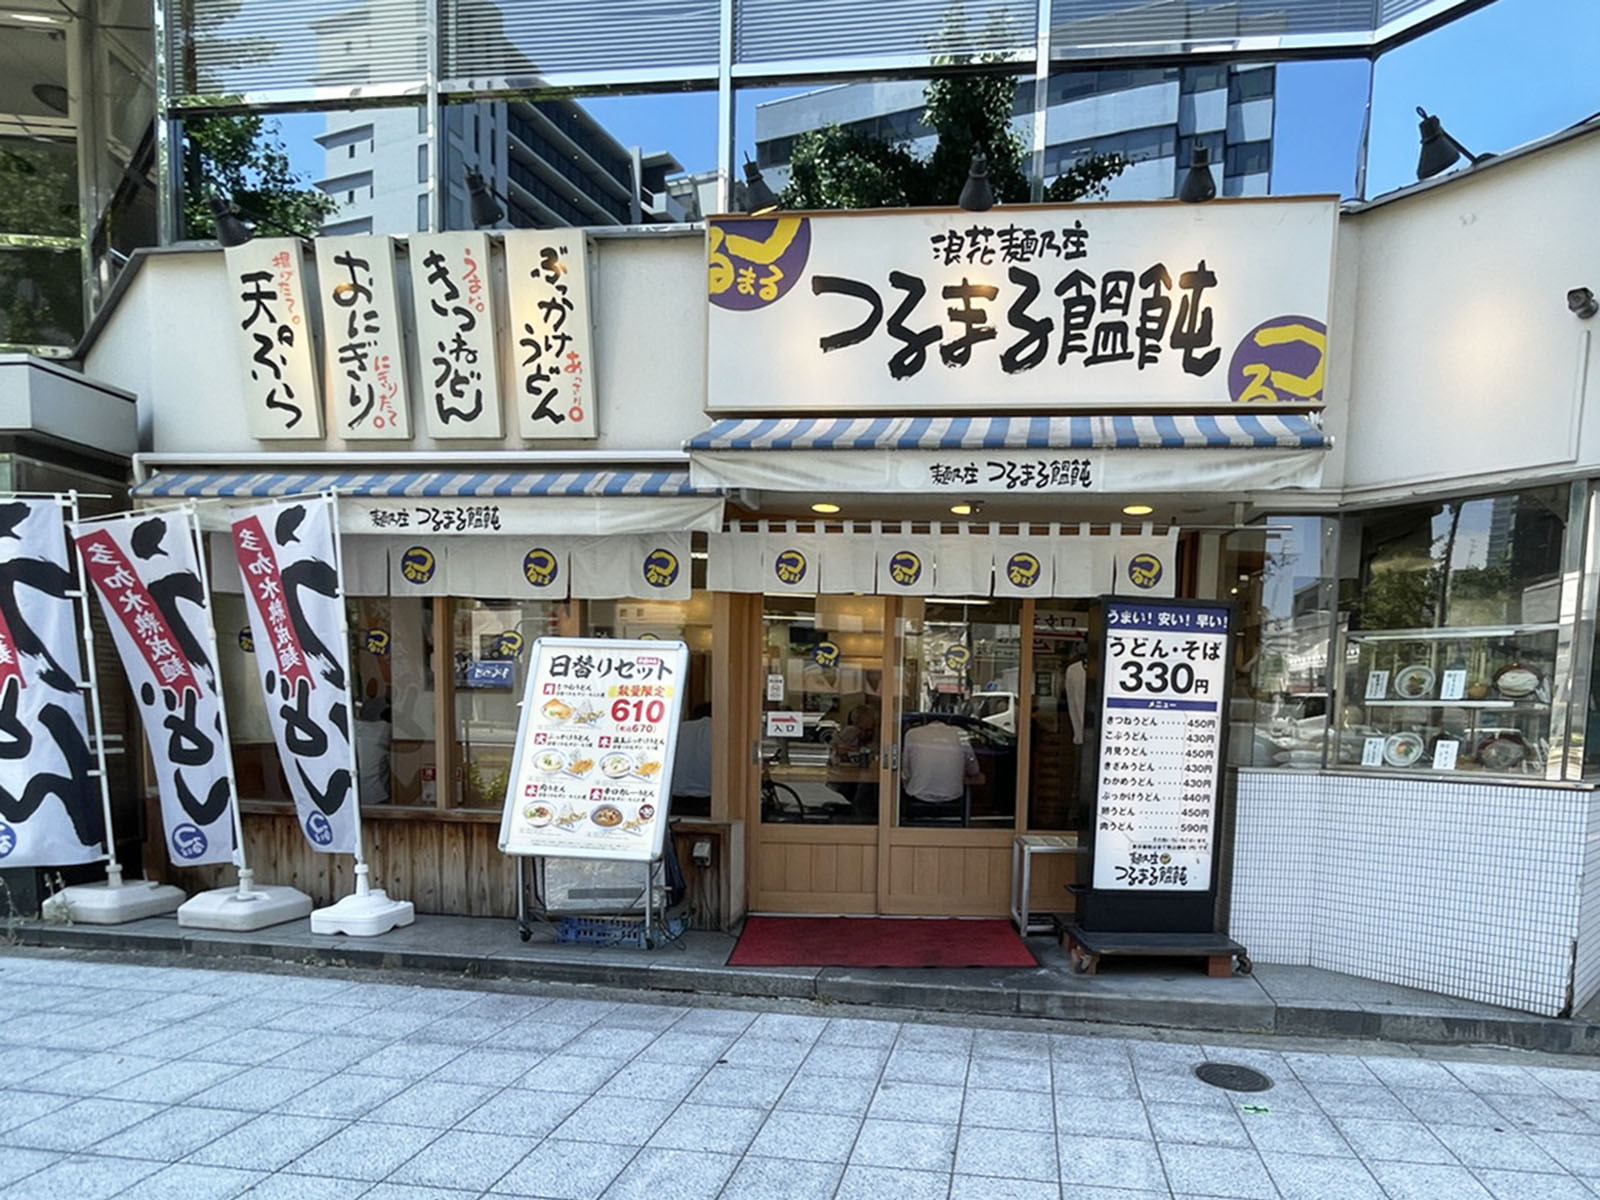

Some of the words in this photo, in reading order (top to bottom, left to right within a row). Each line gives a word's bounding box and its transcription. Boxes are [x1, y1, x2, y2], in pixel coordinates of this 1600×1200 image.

[812, 259, 1222, 381] つるまる饂飩
[240, 270, 303, 429] 天ぷら
[332, 250, 380, 430] おにぎり
[986, 459, 1093, 489] つるまる饂飩
[415, 505, 502, 532] つるまる饂飩
[1107, 609, 1152, 624] うまい！
[1158, 612, 1190, 627] 安い！
[1195, 614, 1228, 629] 早い！
[1110, 637, 1222, 660] うどん・そば
[550, 654, 673, 680] 日替りセット
[1119, 661, 1209, 694] 330円
[611, 698, 665, 724] 610
[1147, 700, 1177, 709] メニュー
[1106, 715, 1157, 726] きつねうどん
[1187, 719, 1216, 729] 450円
[1186, 734, 1215, 744] 430円
[1104, 746, 1148, 757] 月見うどん
[1185, 749, 1214, 759] 450円
[1184, 764, 1213, 774] 430円
[1103, 777, 1154, 787] わかめうどん
[1183, 779, 1212, 789] 430円
[1182, 793, 1211, 803] 440円
[1181, 808, 1210, 818] 450円
[1180, 823, 1209, 833] 590円
[1114, 866, 1189, 886] つるまる饂飩
